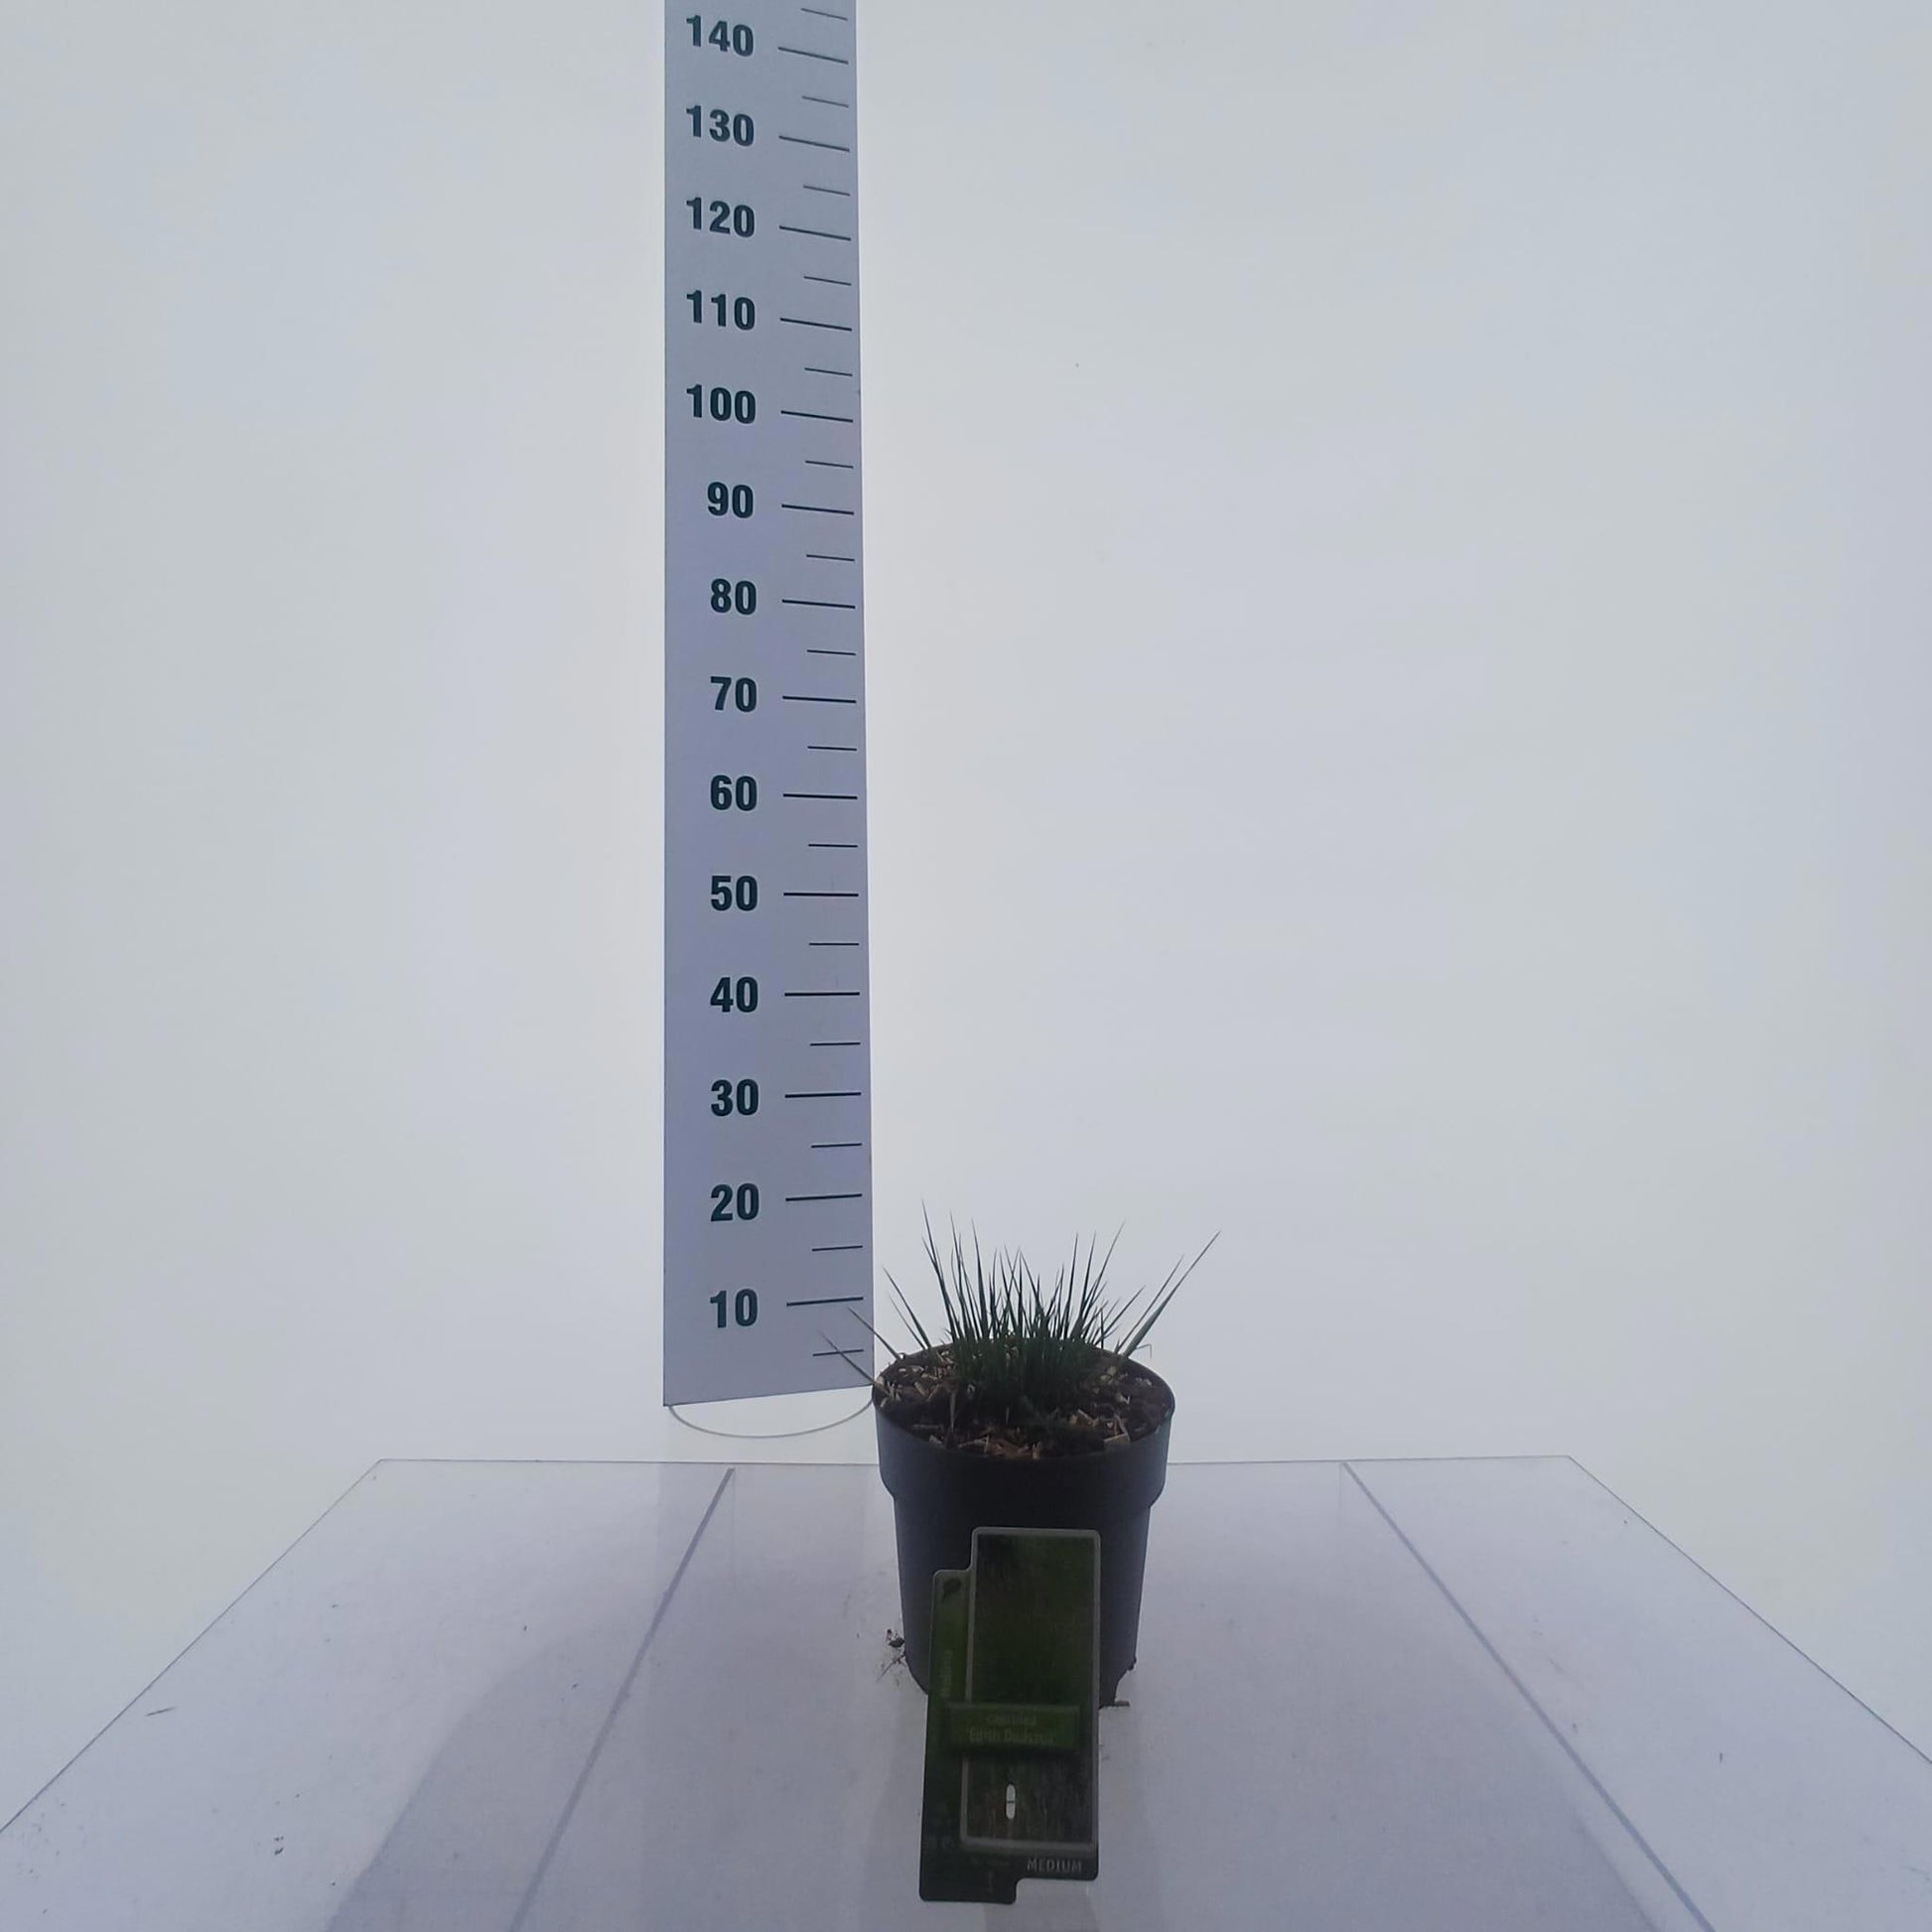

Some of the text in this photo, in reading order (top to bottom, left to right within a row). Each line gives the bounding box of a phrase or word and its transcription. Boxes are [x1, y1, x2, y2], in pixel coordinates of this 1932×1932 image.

[685, 14, 755, 58] 140
[685, 104, 755, 147] 130
[685, 196, 756, 238] 120
[686, 289, 756, 332] 110
[686, 383, 757, 425] 100
[707, 481, 755, 519] 90
[710, 578, 758, 616] 80
[709, 675, 758, 713] 70
[710, 774, 758, 812] 60
[710, 875, 759, 912] 50
[709, 976, 759, 1014] 40
[710, 1078, 759, 1118] 30
[709, 1182, 760, 1223] 20
[709, 1288, 759, 1329] 10
[1026, 1858, 1082, 1873] MEDIUM
